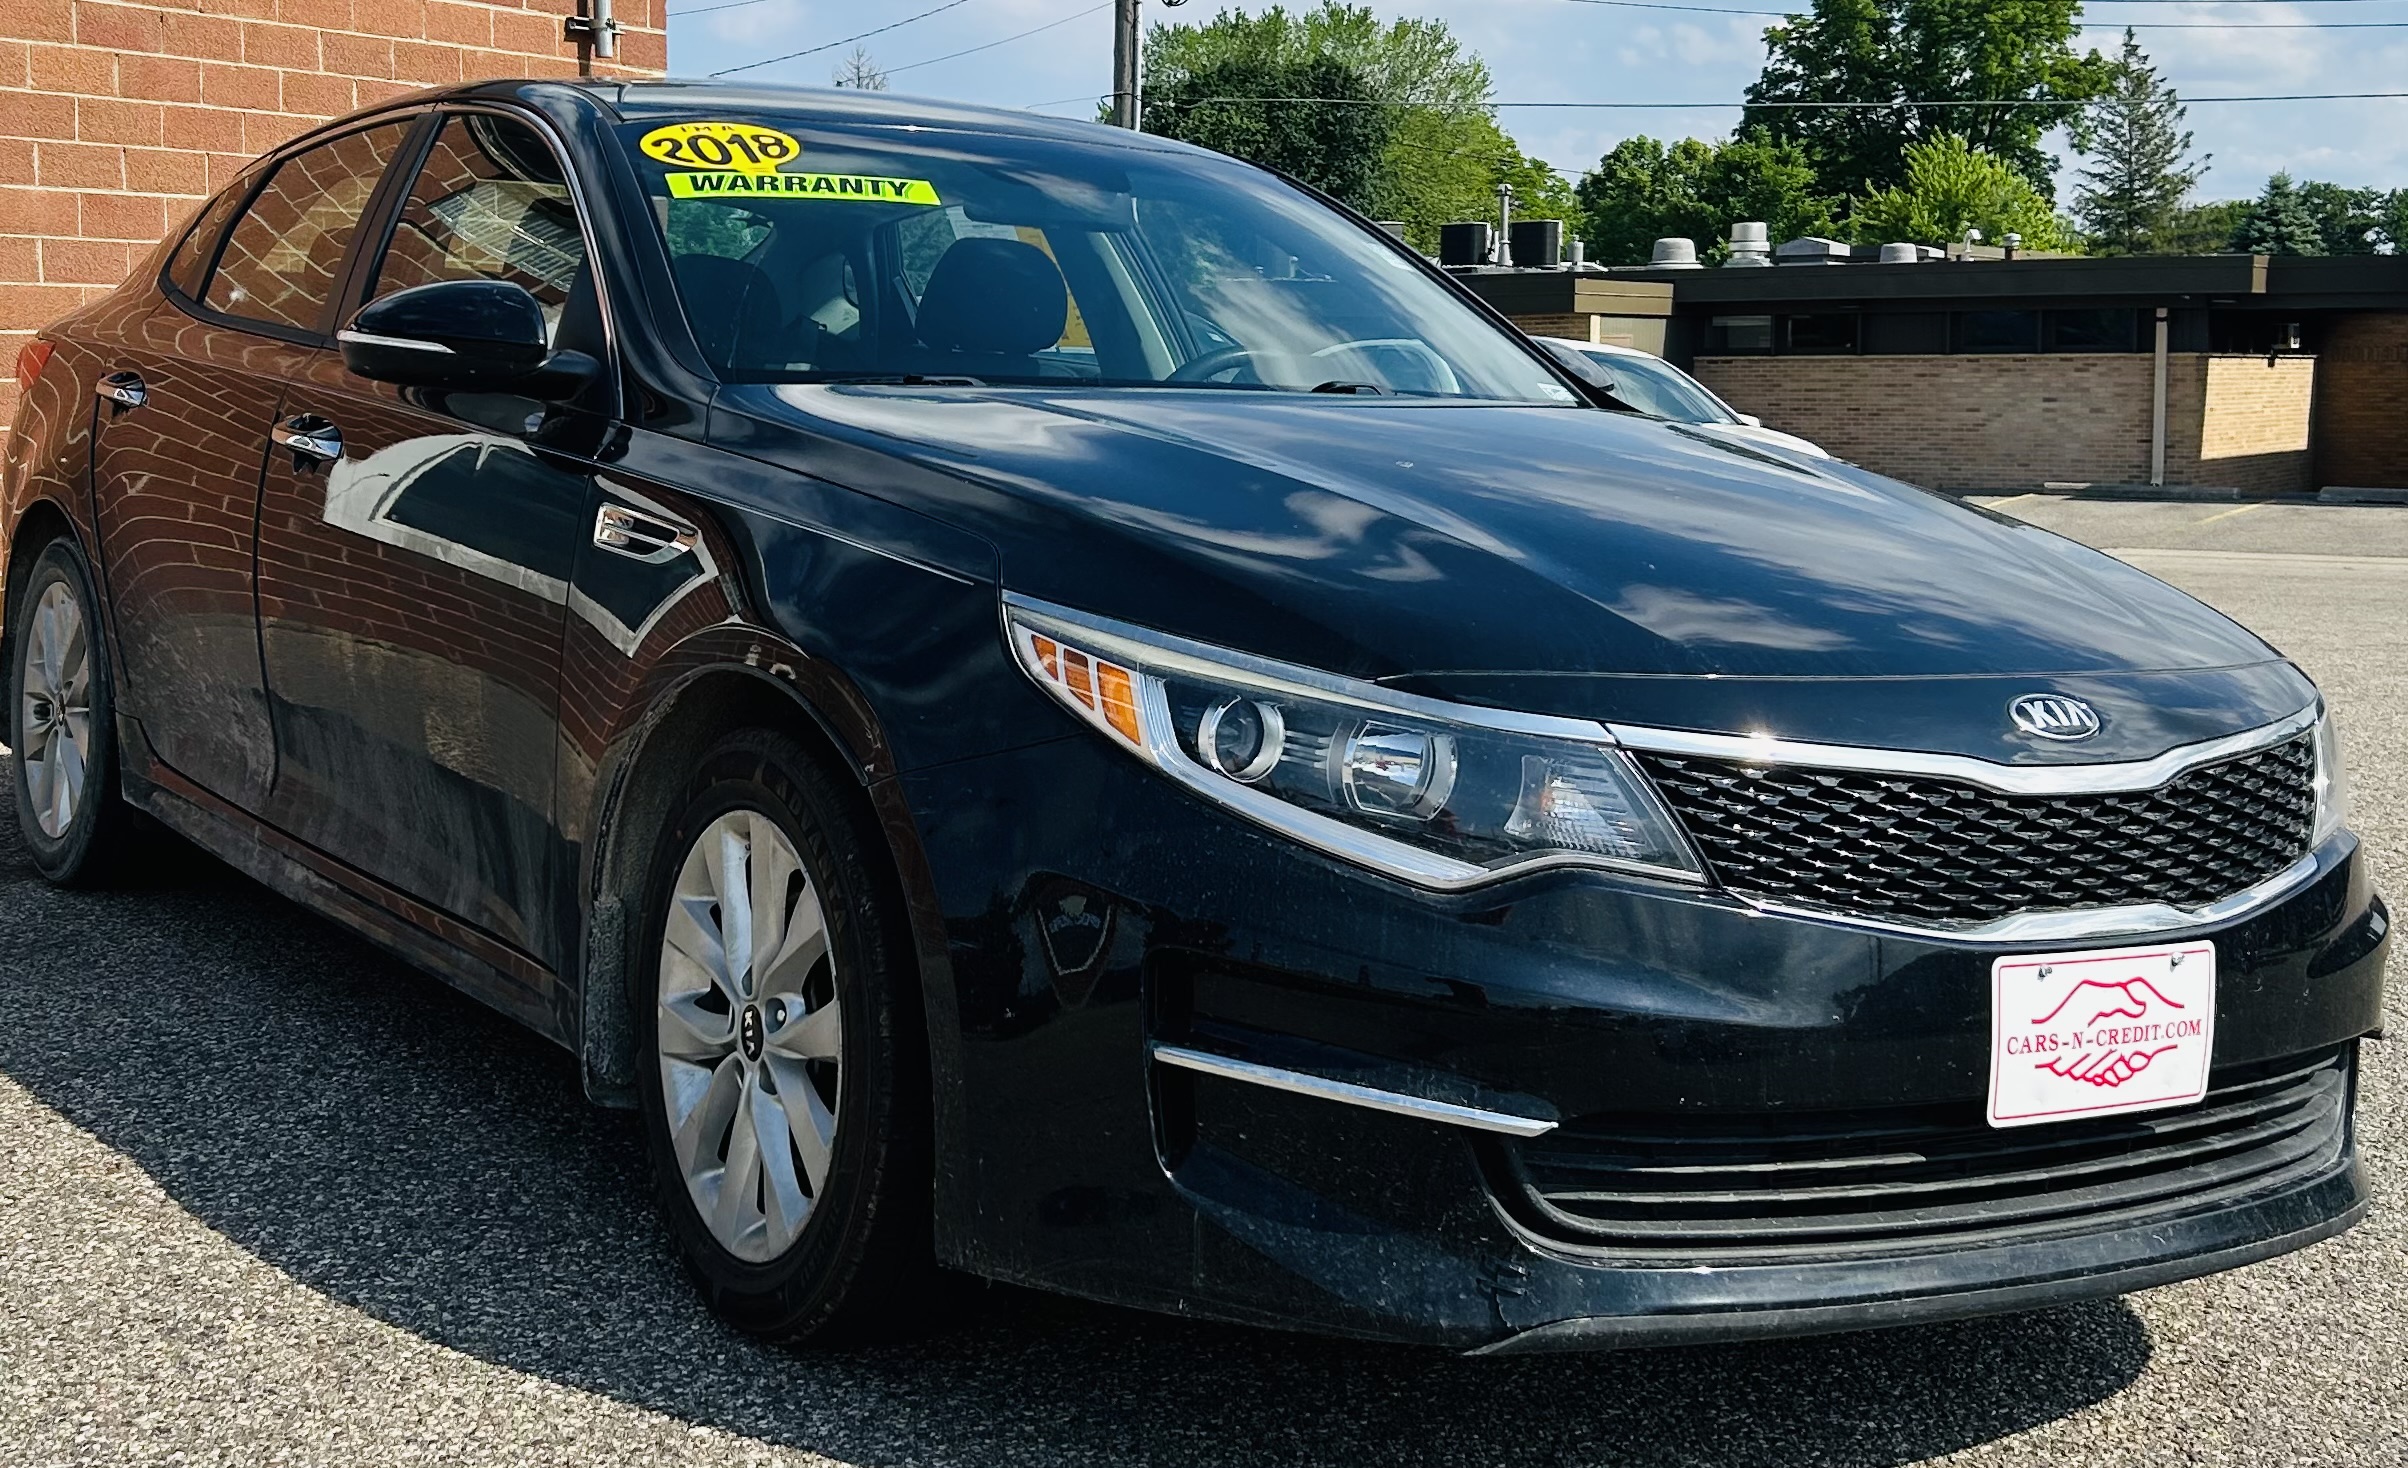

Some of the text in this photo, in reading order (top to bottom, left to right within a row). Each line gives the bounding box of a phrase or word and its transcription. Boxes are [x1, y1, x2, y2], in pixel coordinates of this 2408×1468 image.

[651, 134, 790, 165] 2018
[688, 174, 911, 196] WARRANTY
[2019, 699, 2094, 729] KIA
[744, 1010, 755, 1056] KIA
[2007, 1018, 2202, 1055] CARS-N-CREDIT.COM
